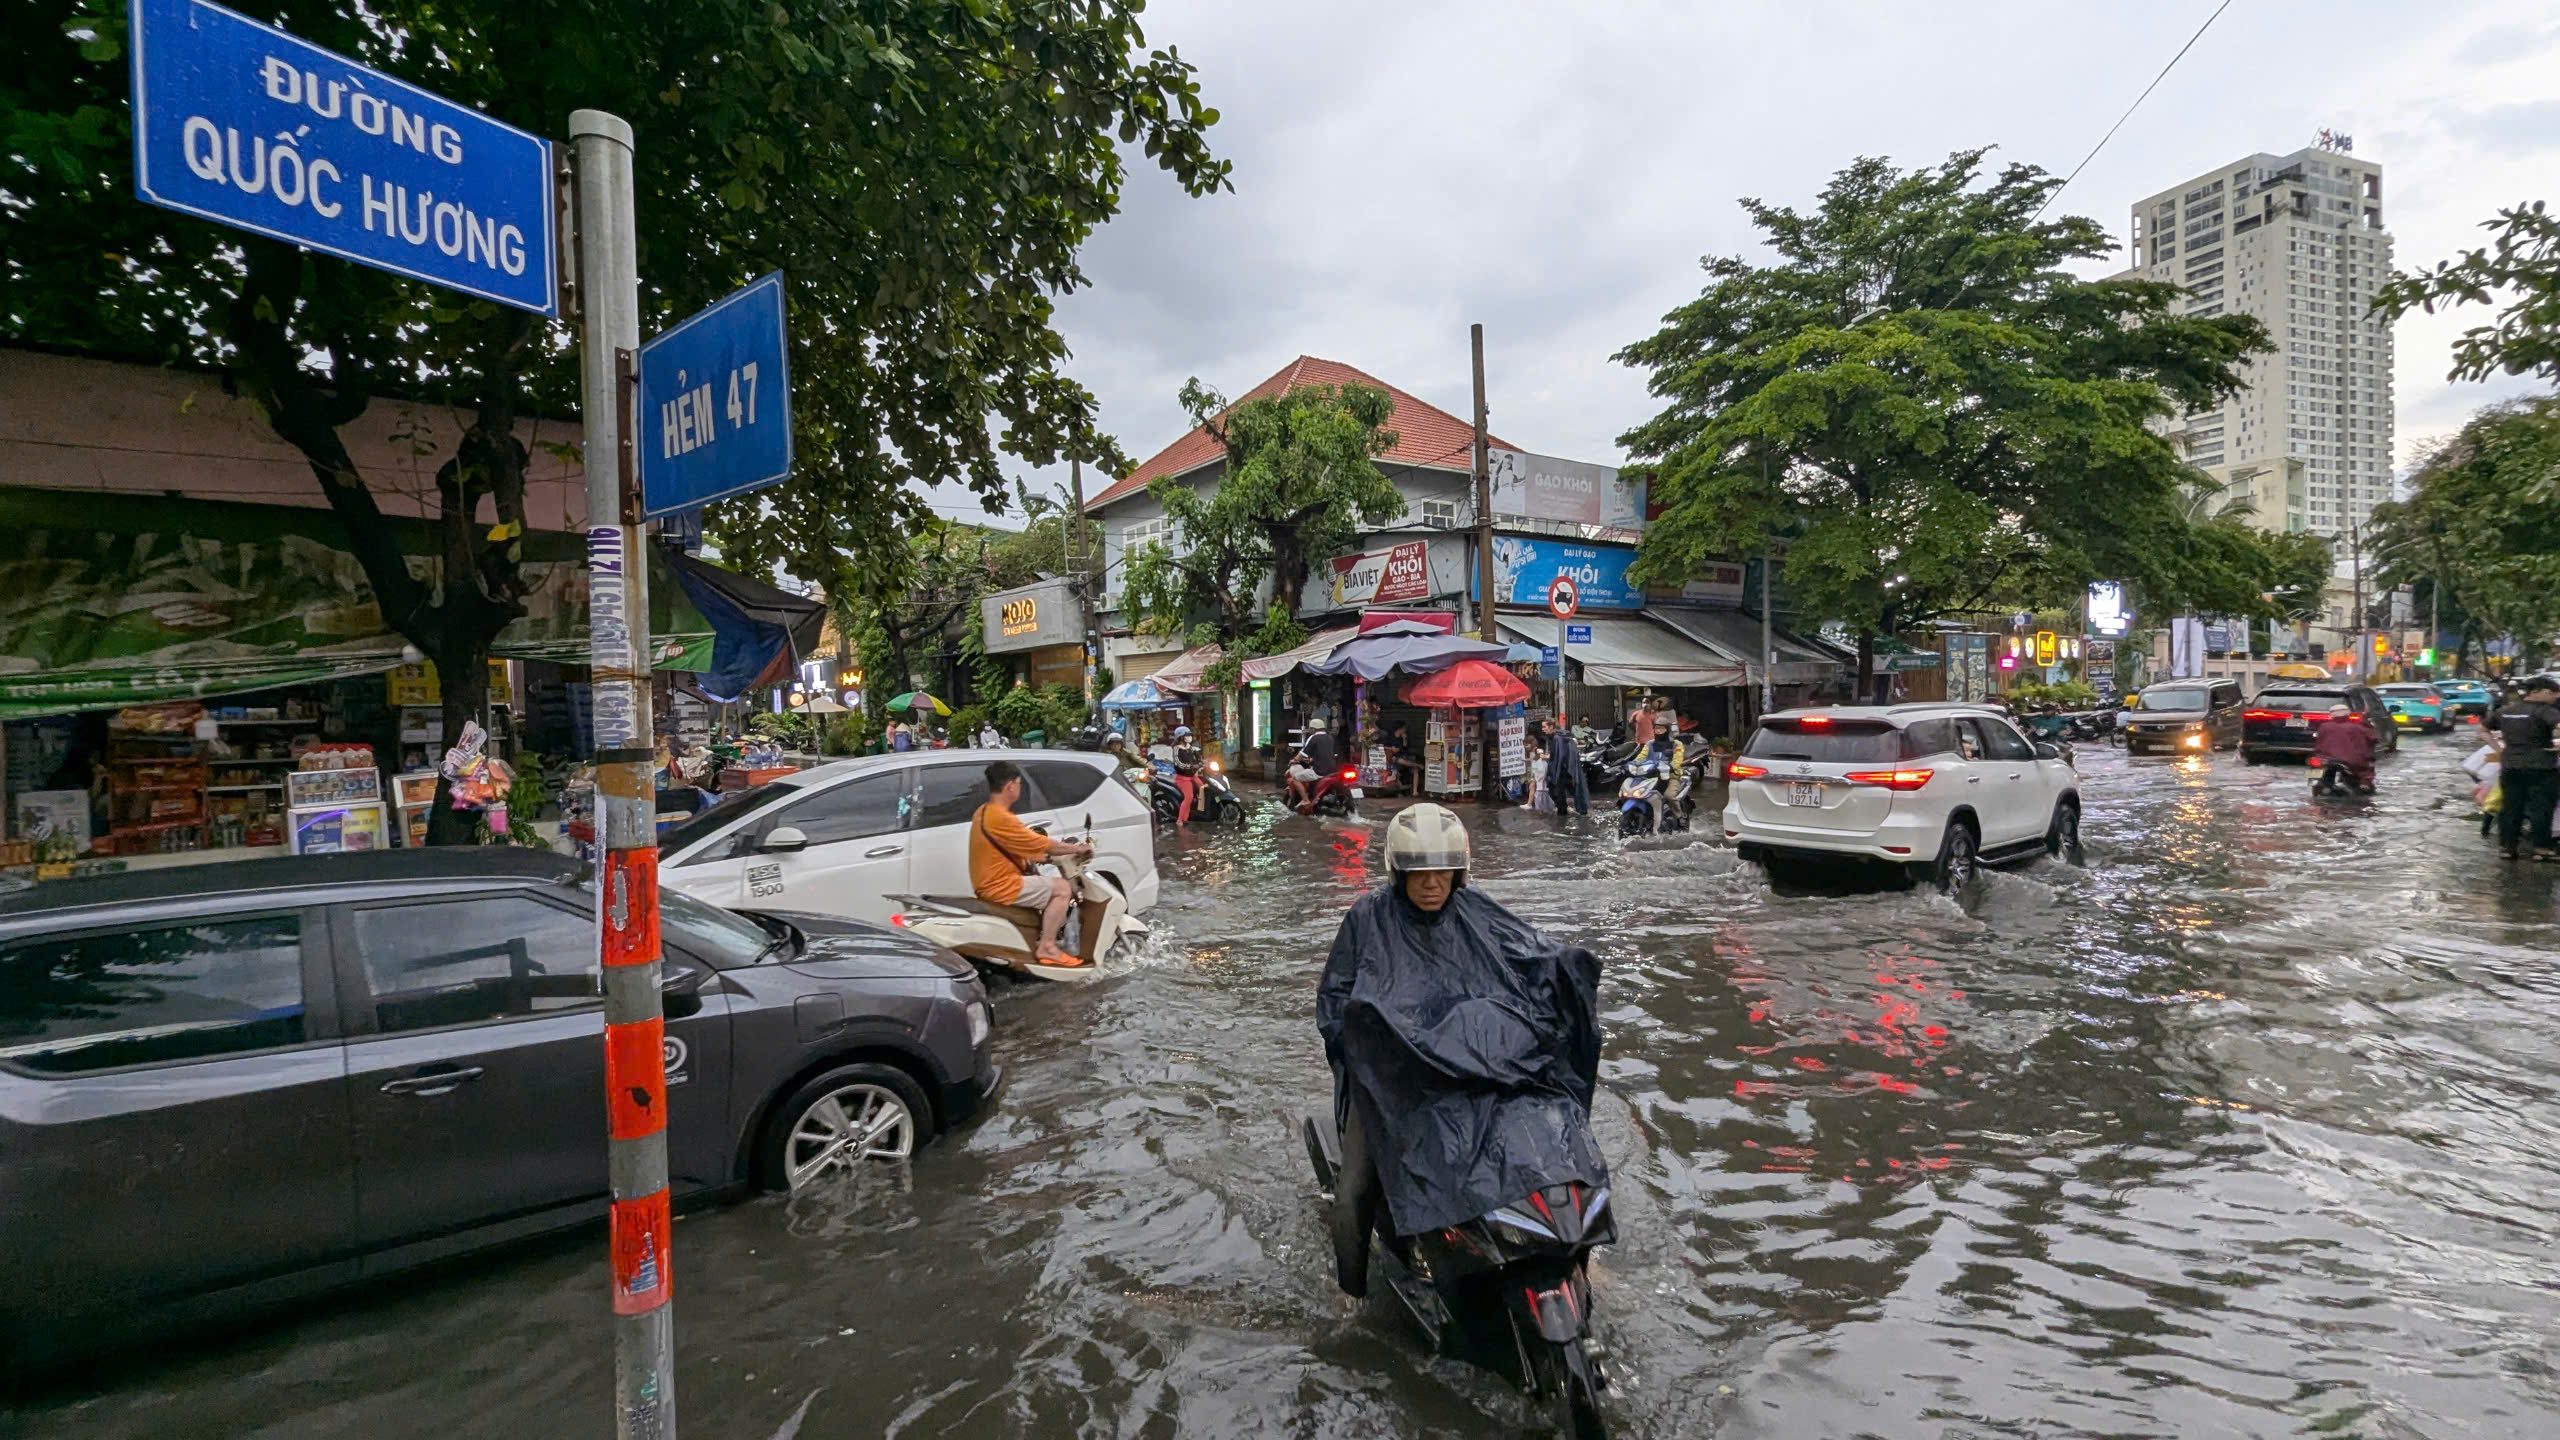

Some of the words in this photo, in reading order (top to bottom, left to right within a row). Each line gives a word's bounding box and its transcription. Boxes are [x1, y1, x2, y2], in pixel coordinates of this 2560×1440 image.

[260, 56, 463, 165] ĐƯỜNG
[183, 115, 342, 219] QUỐC
[363, 173, 526, 277] HƯƠNG
[662, 368, 714, 460] HẺM
[726, 361, 759, 429] 47
[1535, 472, 1561, 490] GẠO
[1396, 548, 1408, 558] ĐẠI
[1410, 545, 1419, 555] LÝ
[1564, 548, 1574, 558] ĐẠI
[1575, 548, 1582, 558] LÝ
[1583, 550, 1596, 560] GẠO
[1389, 556, 1422, 576] KHÔI
[1557, 564, 1599, 584] KHÔI
[1790, 795, 1819, 805] 197.14
[751, 883, 784, 898] 1900
